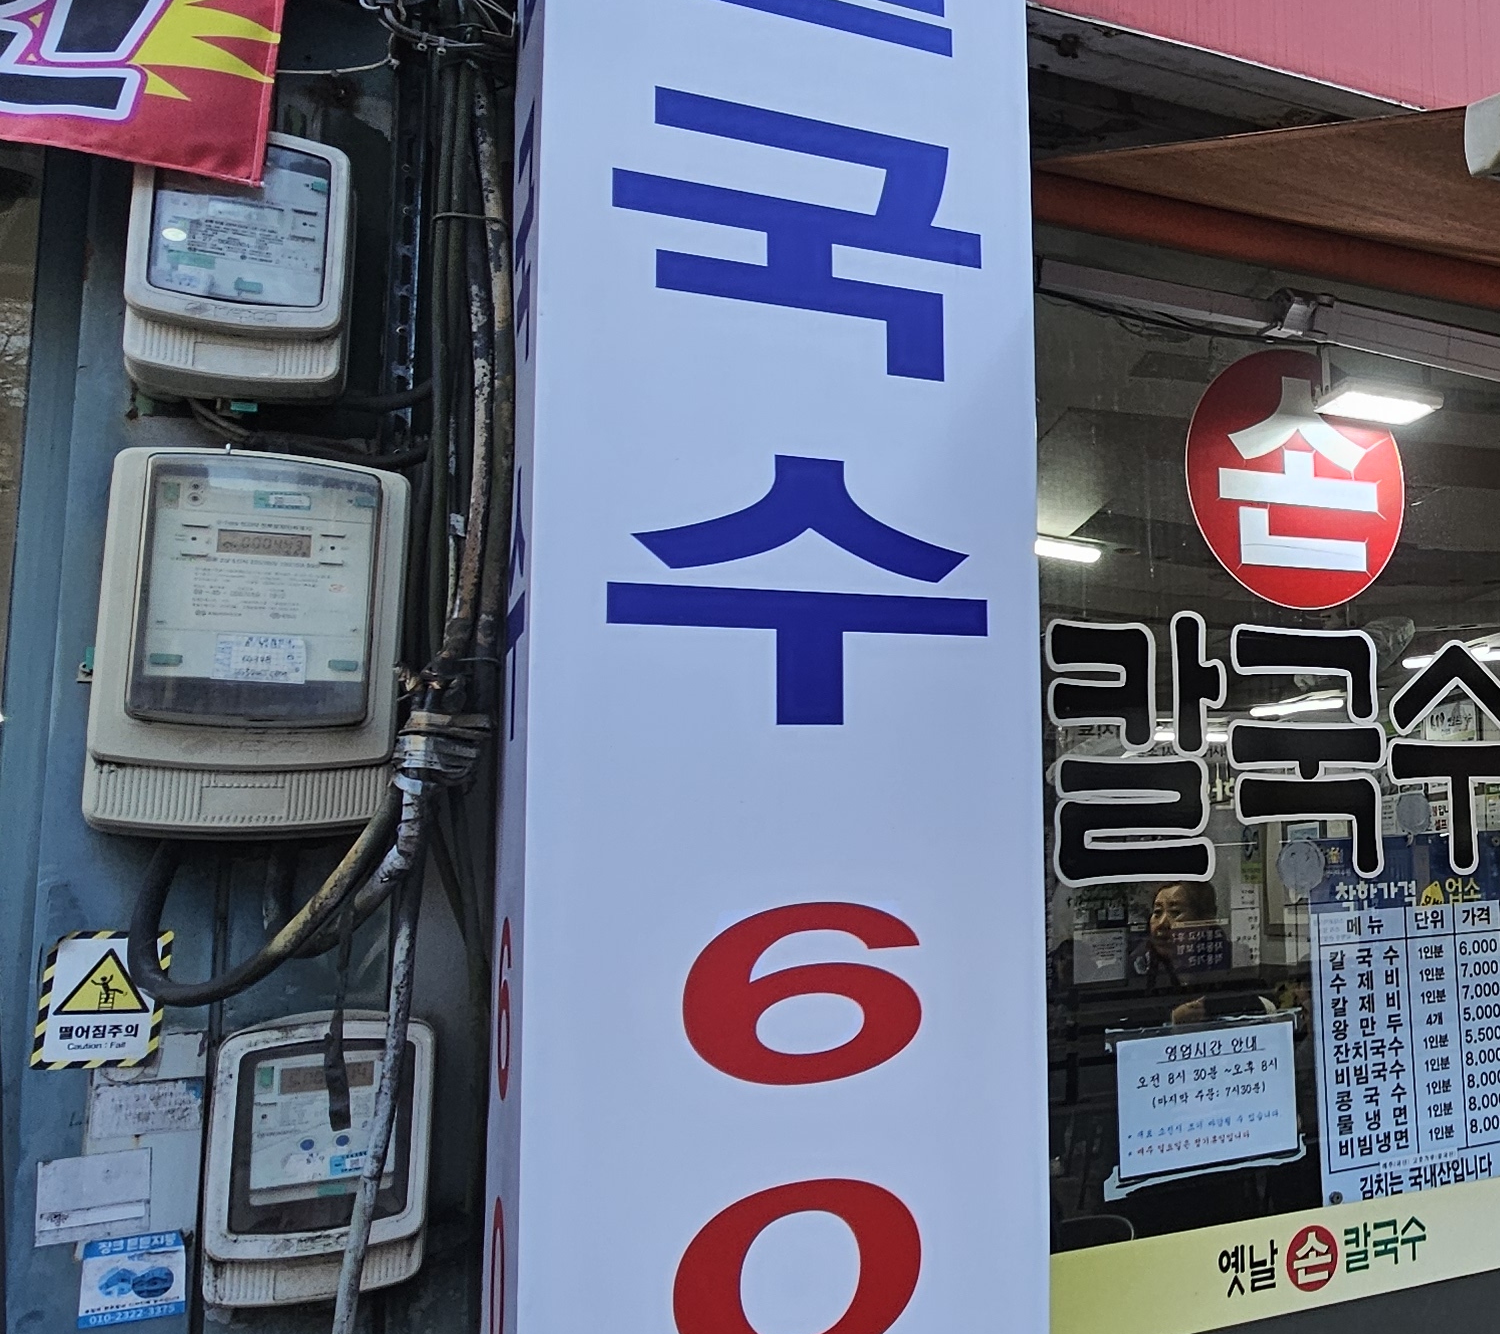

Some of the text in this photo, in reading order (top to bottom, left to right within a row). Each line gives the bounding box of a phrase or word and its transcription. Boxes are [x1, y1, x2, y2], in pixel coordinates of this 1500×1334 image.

[1218, 376, 1379, 572] 손
[1414, 910, 1445, 930] 단위
[1462, 906, 1491, 926] 가격
[1418, 944, 1444, 959] 1인분
[1419, 967, 1445, 982] 1인분
[1420, 989, 1446, 1004] 1인분
[1426, 1012, 1443, 1026] 4개
[58, 1023, 140, 1041] 떨어짐주의
[67, 1041, 101, 1052] Caution
[110, 1041, 127, 1051] Fall
[1165, 1035, 1258, 1063] 영업시간 안내
[1333, 1036, 1405, 1065] 잔치국수
[1423, 1033, 1449, 1050] 1인분
[1136, 1073, 1160, 1089] 오전
[1167, 1069, 1186, 1085] 8시
[1193, 1065, 1218, 1082] 30분
[1261, 1057, 1278, 1072] 8시
[1334, 1059, 1406, 1088] 비빔국수
[1424, 1056, 1450, 1072] 1인분
[1426, 1078, 1452, 1095] 1인분
[1152, 1091, 1189, 1109] (마지막
[1427, 1101, 1453, 1118] 1인분
[1339, 1127, 1410, 1159] 비빔냉면
[1428, 1124, 1455, 1142] 1인분
[1360, 1152, 1493, 1200] 김치는 국내산입니다
[1218, 1215, 1427, 1298] 옛날 손 칼국수
